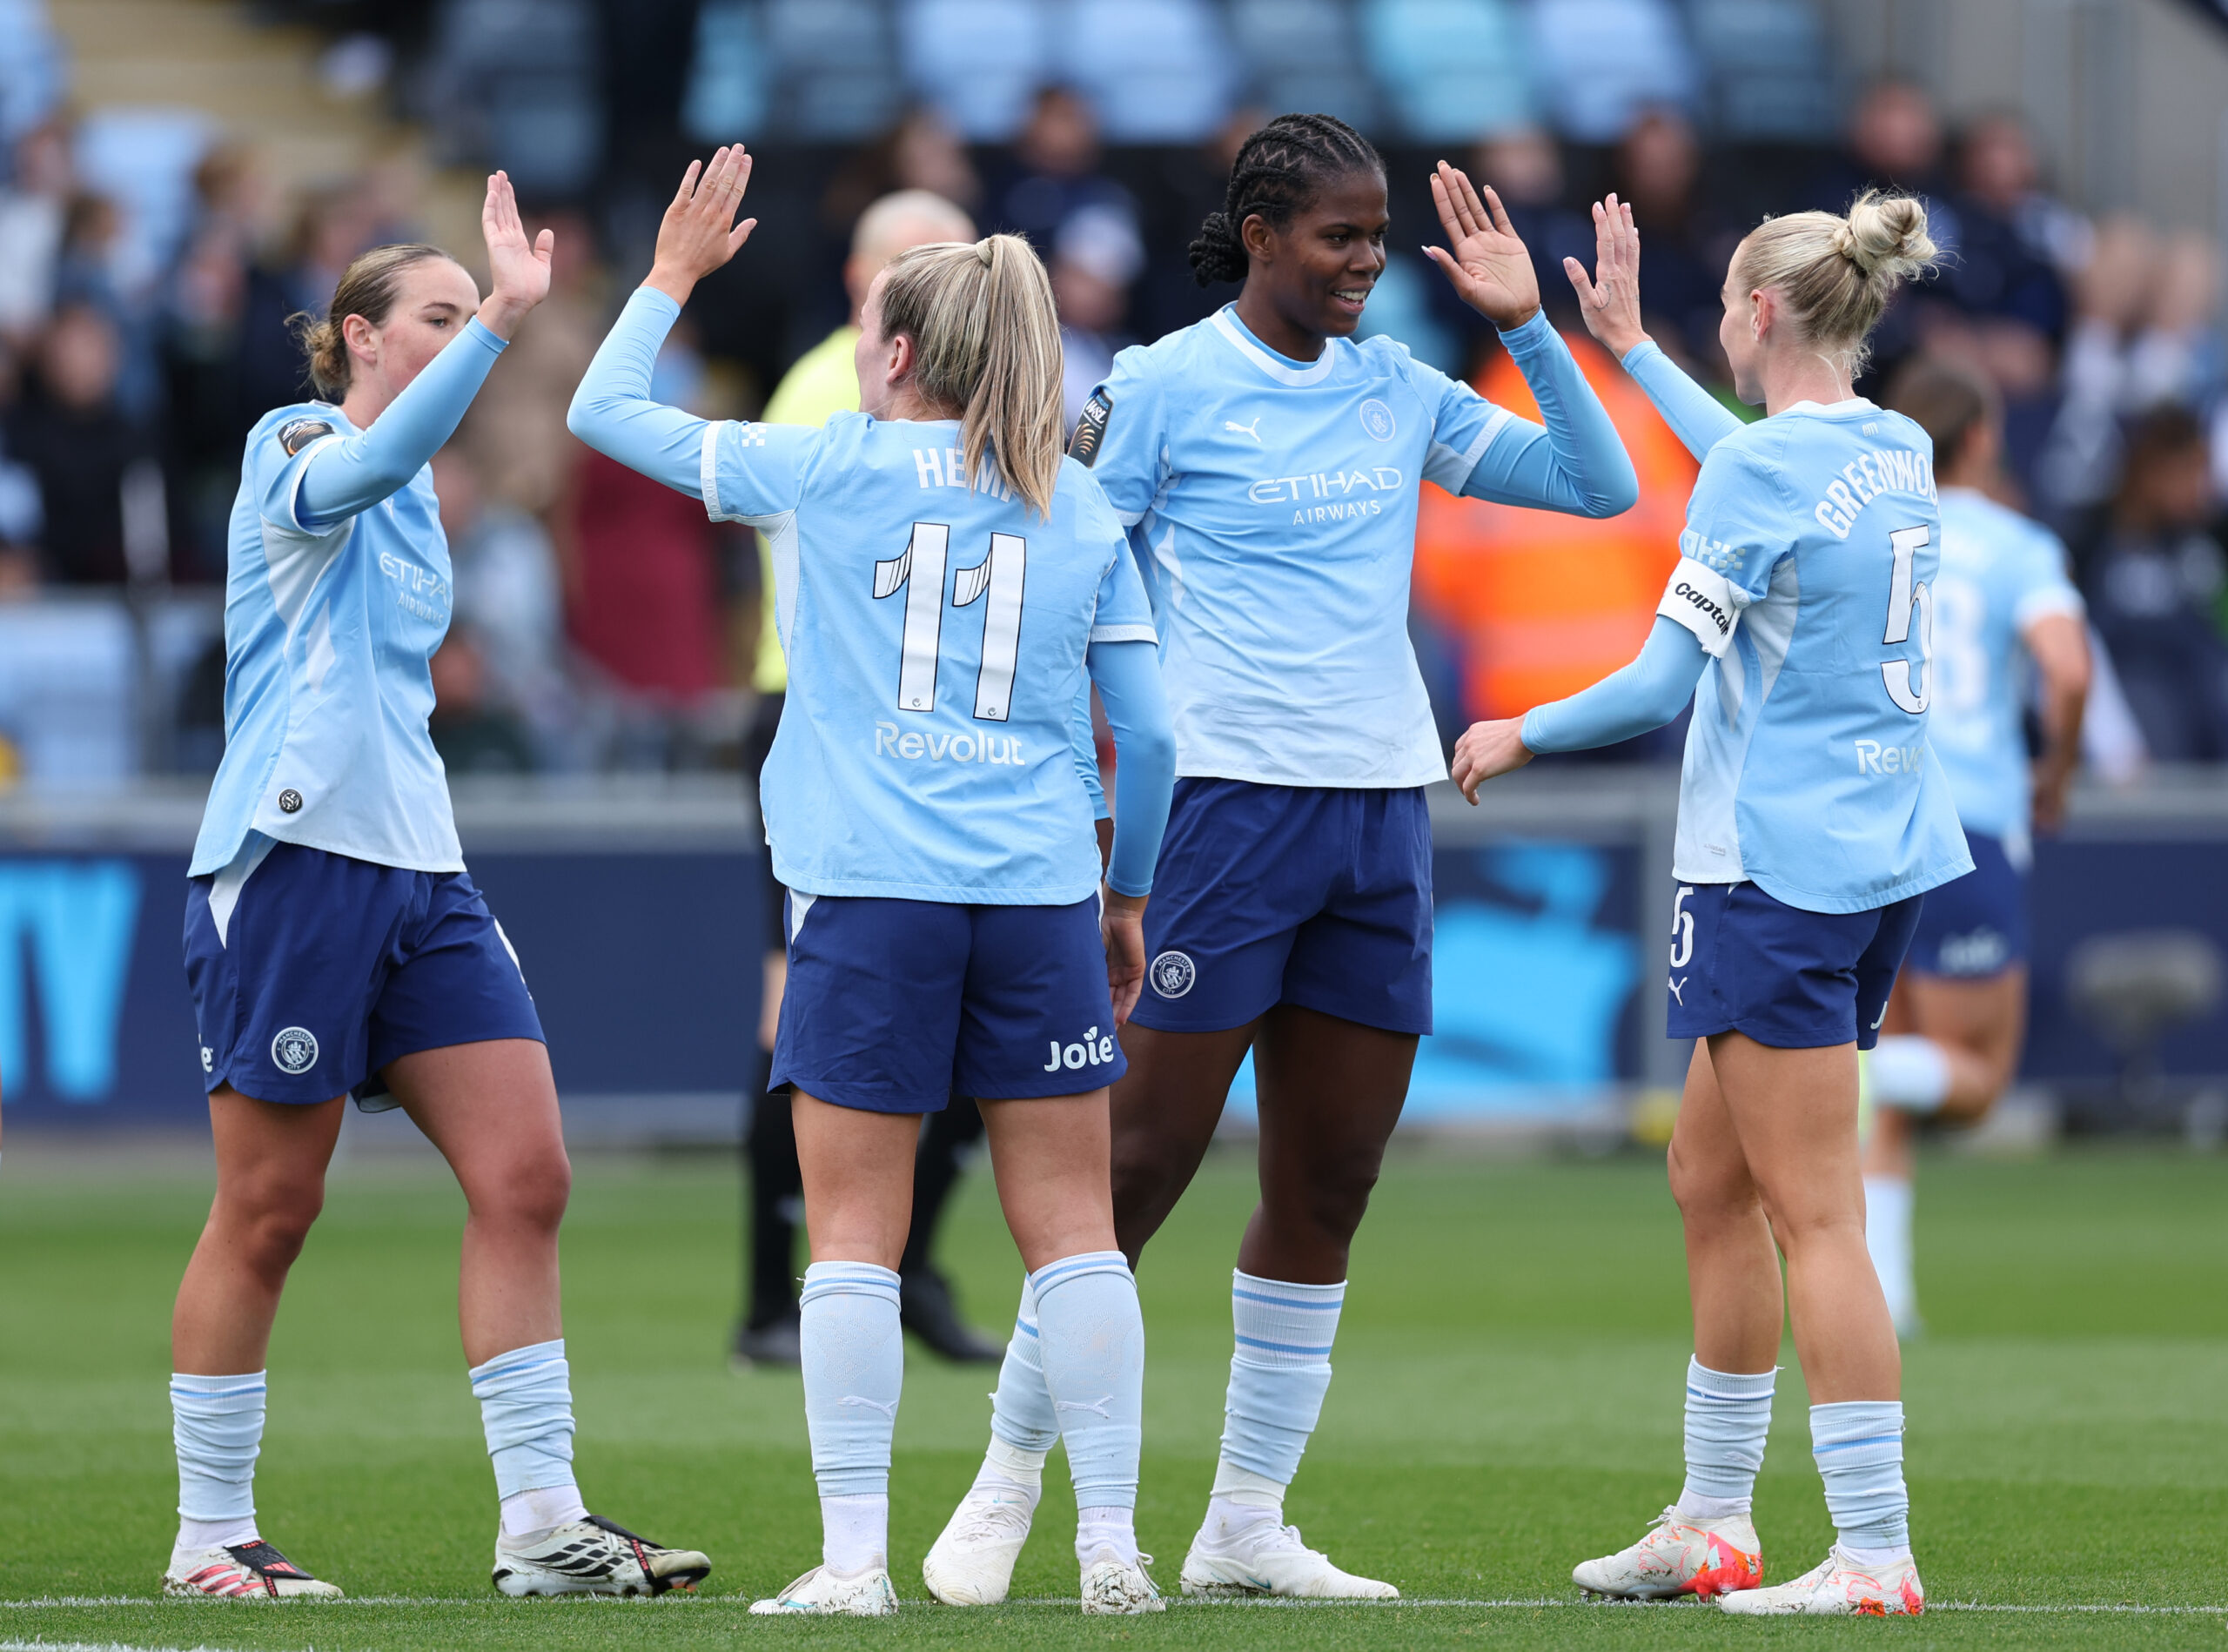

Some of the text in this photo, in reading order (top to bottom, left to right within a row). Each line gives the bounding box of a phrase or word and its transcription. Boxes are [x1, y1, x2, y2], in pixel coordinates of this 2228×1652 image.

[1085, 400, 1106, 424] WSL
[912, 447, 1012, 503] HEM
[1248, 467, 1402, 504] ETIHAD
[1815, 450, 1941, 540] GREENWOO
[1293, 500, 1381, 527] AIRWAYS
[379, 552, 453, 610] ETIHA
[397, 592, 444, 628] AIRWAYS
[873, 521, 1026, 722] 11
[1880, 524, 1932, 714] 5
[876, 720, 1025, 766] Revolut
[1854, 739, 1924, 775] Revo
[1670, 887, 1694, 968] 5
[1158, 955, 1191, 972] MANCHESTER
[278, 1031, 313, 1046] MANCHESTER
[1044, 1025, 1114, 1071] Joie
